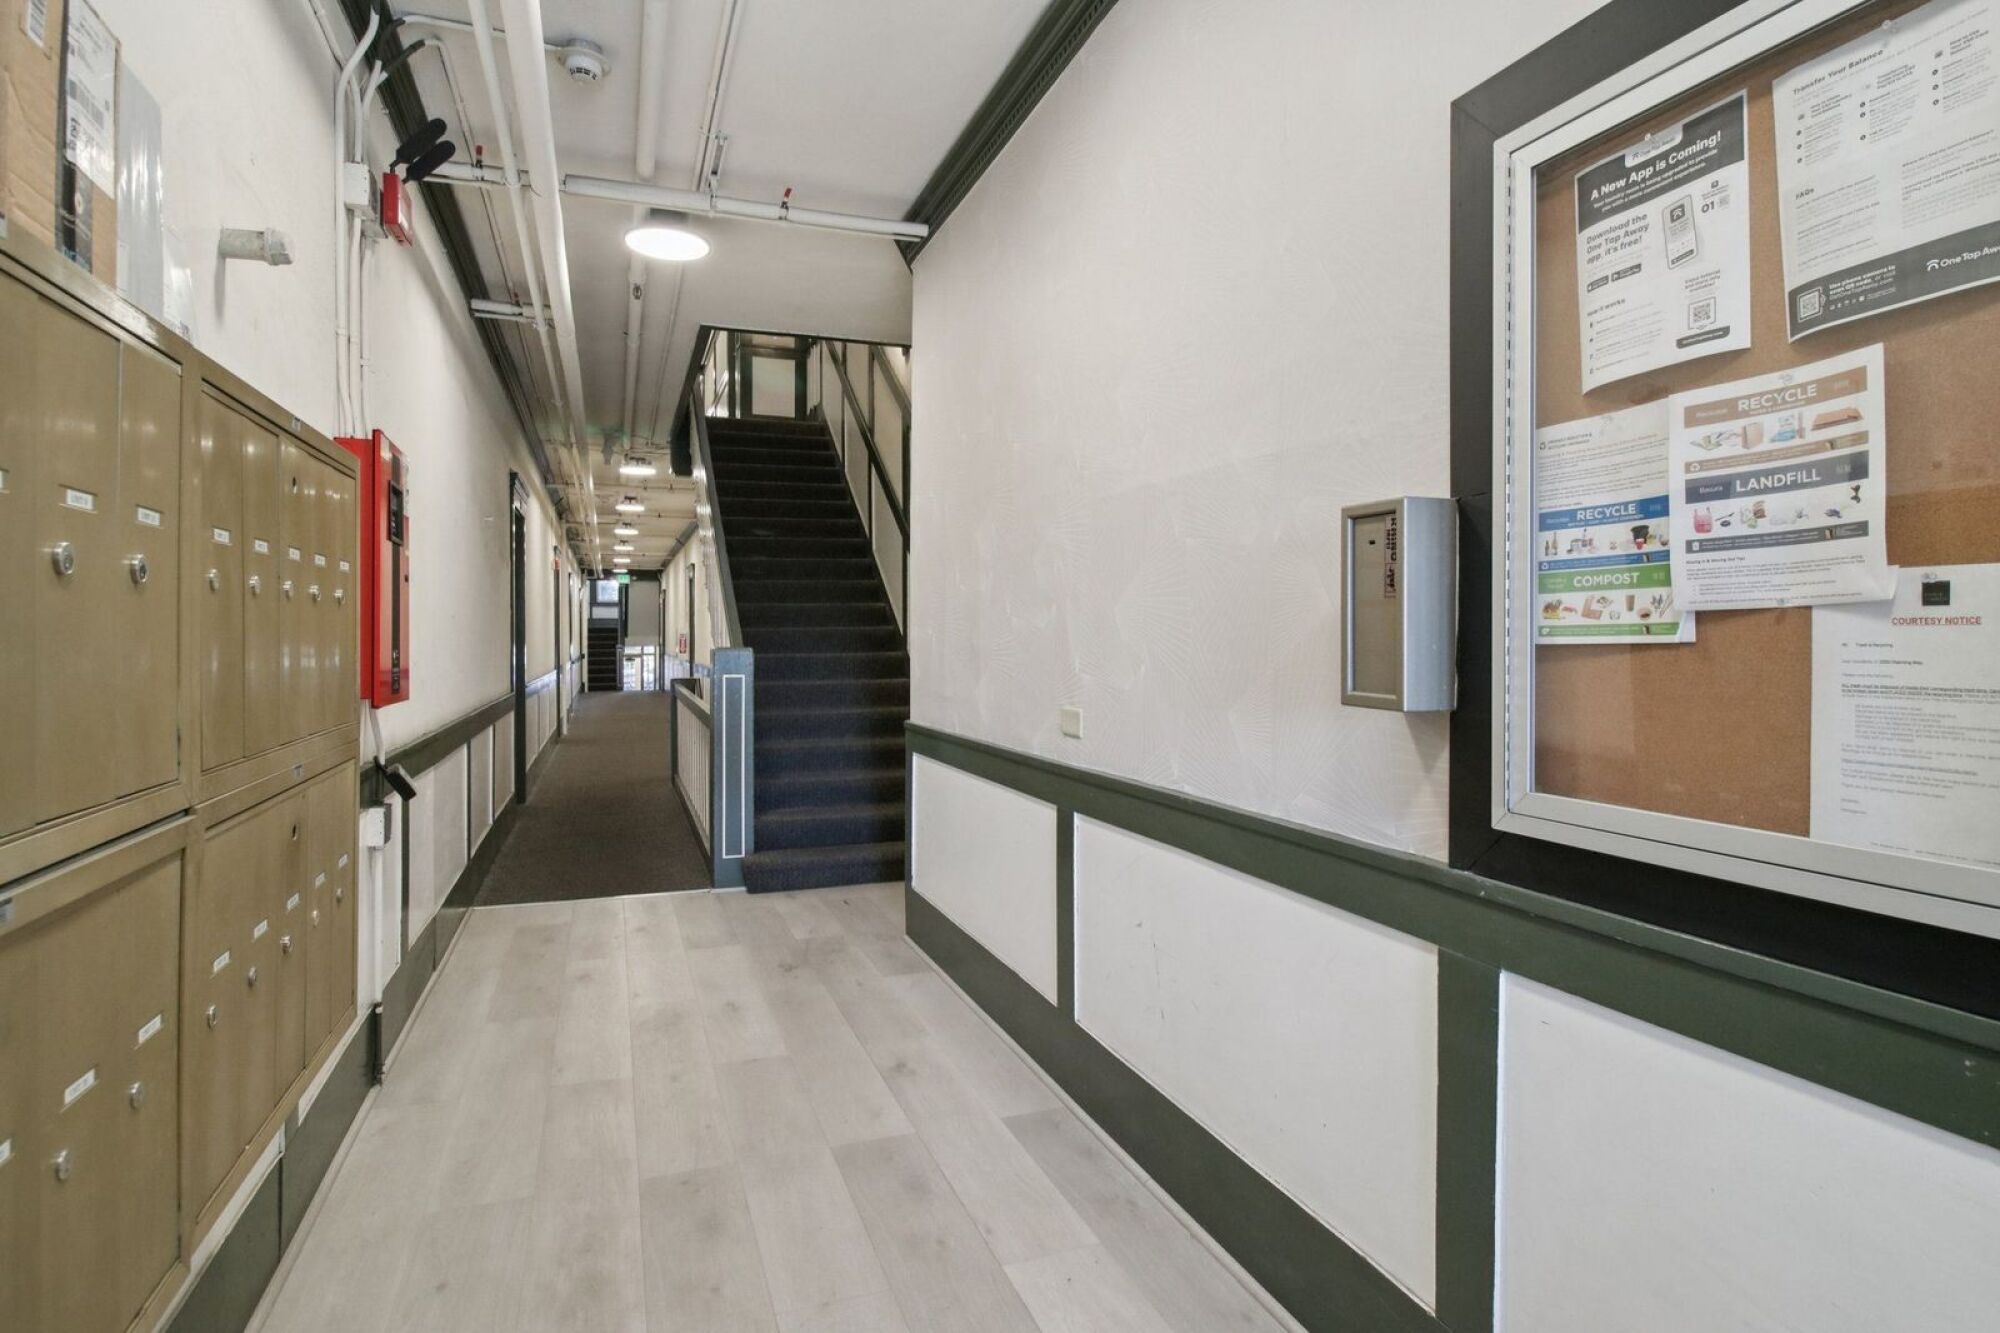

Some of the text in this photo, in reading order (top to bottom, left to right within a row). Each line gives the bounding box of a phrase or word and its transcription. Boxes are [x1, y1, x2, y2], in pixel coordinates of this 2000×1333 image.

[1828, 66, 1846, 78] Your
[1848, 49, 1884, 69] Balance
[1590, 189, 1599, 201] A
[1600, 177, 1627, 197] New
[1628, 165, 1654, 184] App
[1655, 159, 1667, 171] is
[1668, 129, 1721, 164] Coming!
[1701, 200, 1715, 213] 01
[1586, 213, 1648, 245] Download the
[1604, 234, 1621, 246] Tap
[1623, 223, 1650, 239] Away
[1620, 234, 1642, 251] free!
[1737, 383, 1818, 412] RECYCLE
[1735, 468, 1822, 492] LANDFILL
[1577, 503, 1637, 521] RECYCLE
[1573, 572, 1640, 588] COMPOST
[1891, 615, 1983, 626] COURTESY NOTICE
